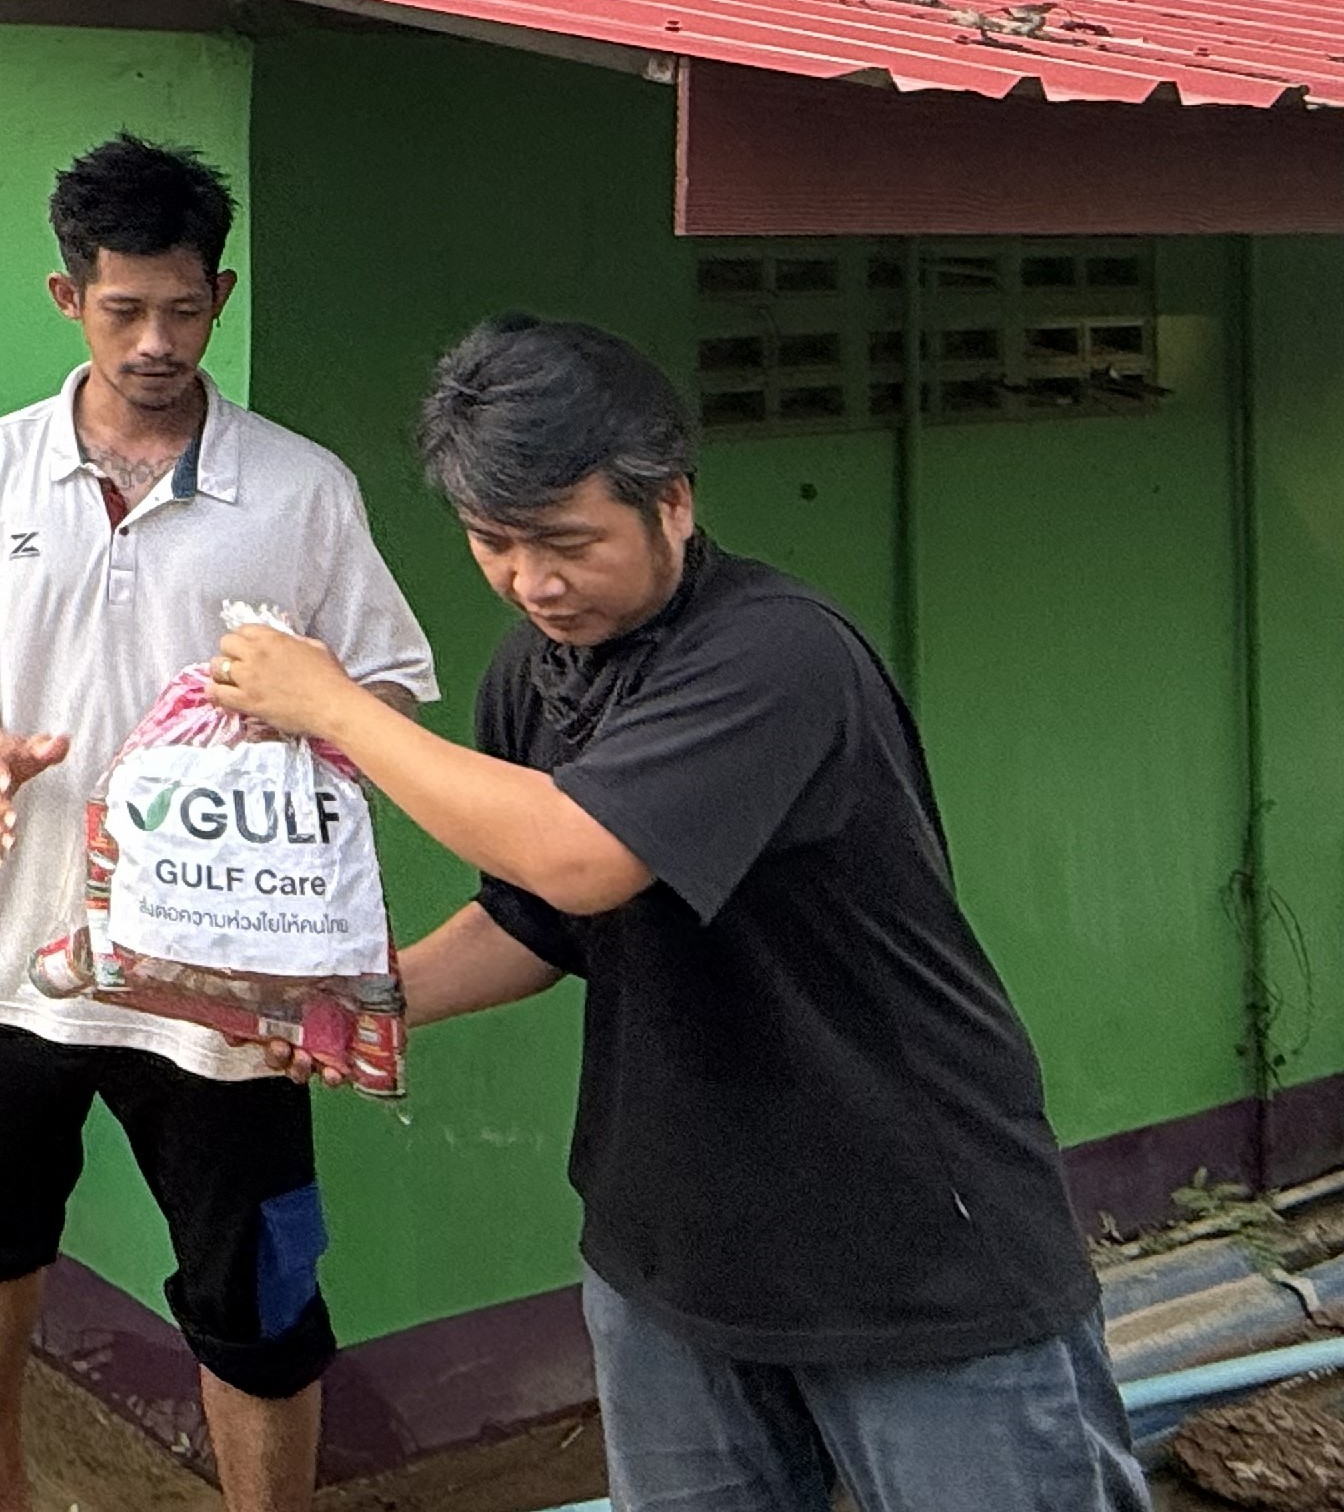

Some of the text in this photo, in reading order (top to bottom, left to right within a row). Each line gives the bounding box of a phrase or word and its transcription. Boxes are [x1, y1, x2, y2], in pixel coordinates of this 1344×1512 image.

[180, 788, 340, 844] GULF
[155, 859, 327, 896] GULF Care
